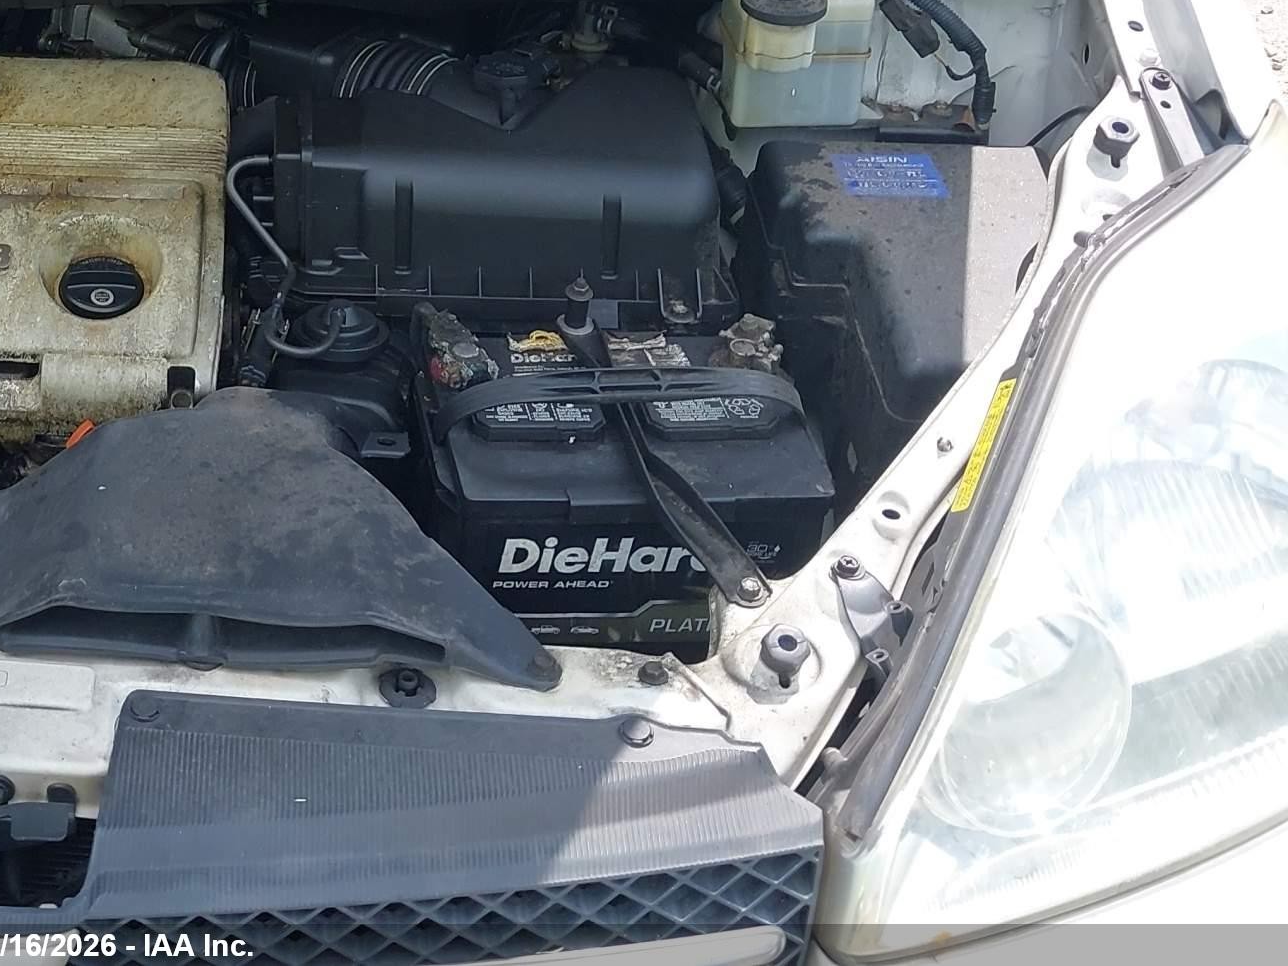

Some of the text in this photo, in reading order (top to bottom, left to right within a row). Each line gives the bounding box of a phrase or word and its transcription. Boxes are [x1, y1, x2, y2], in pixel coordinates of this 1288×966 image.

[510, 351, 576, 363] DieHar
[492, 579, 610, 589] POWER AHEAD
